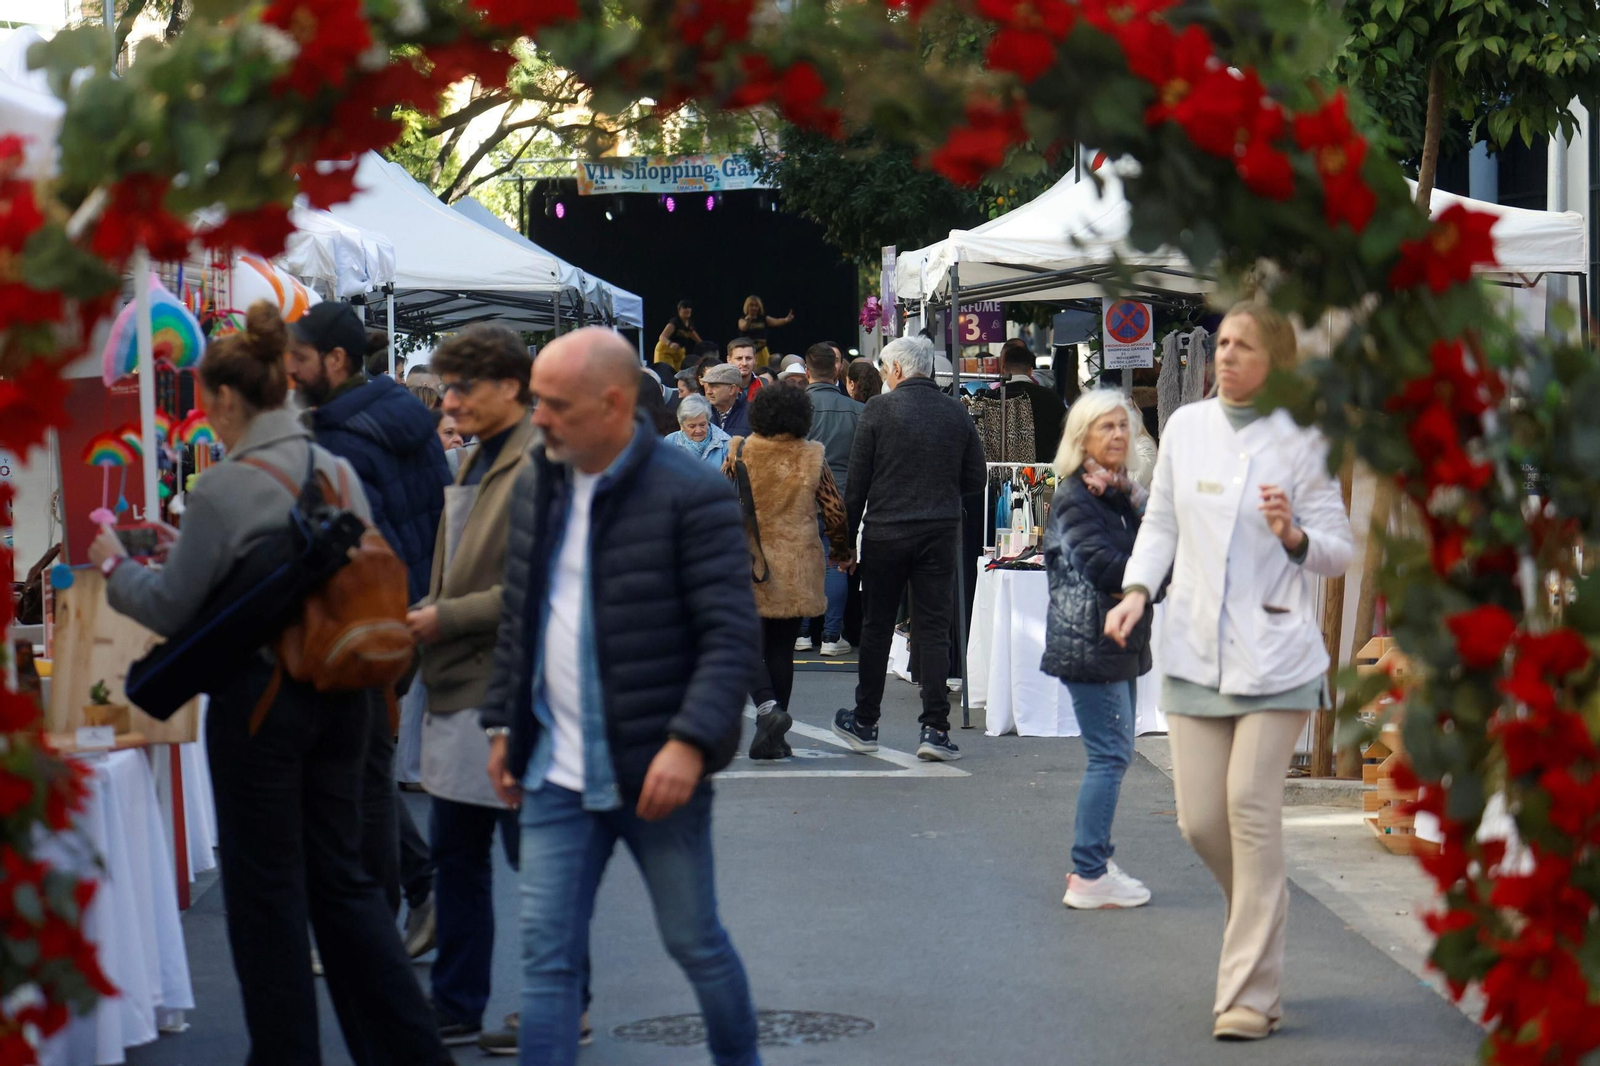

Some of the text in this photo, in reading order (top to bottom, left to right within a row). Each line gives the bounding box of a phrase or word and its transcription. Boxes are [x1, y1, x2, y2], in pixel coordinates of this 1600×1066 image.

[584, 163, 615, 180] VII
[621, 160, 715, 183] Shopping
[965, 313, 981, 341] 3
